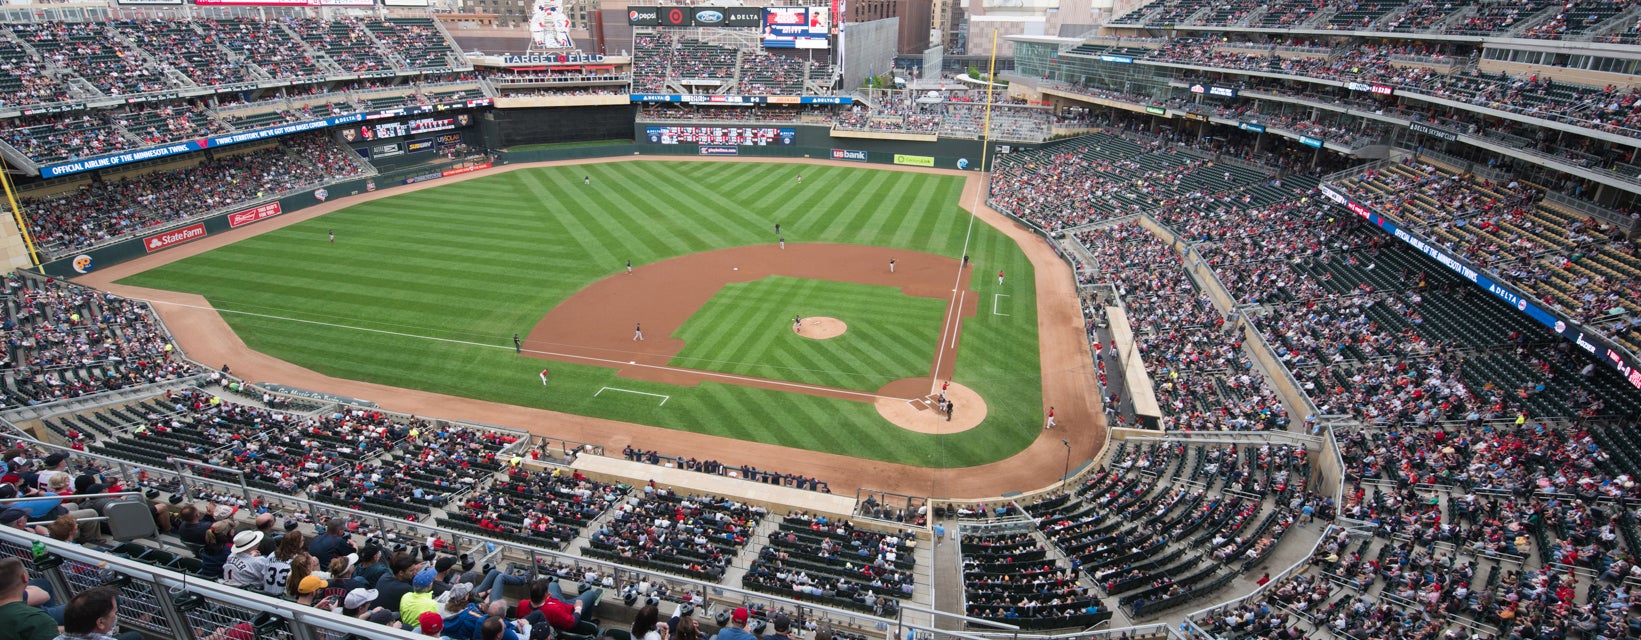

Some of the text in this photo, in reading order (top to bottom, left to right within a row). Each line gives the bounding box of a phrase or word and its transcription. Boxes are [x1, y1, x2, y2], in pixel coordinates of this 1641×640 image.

[701, 12, 718, 21] Ford
[503, 54, 605, 63] TARGET FIELD
[214, 136, 232, 145] TWINS
[260, 130, 274, 138] WE'VE
[274, 128, 284, 136] GOT
[284, 126, 296, 134] YOUR
[296, 124, 309, 132] BASES
[1413, 124, 1428, 133] DELTA
[409, 141, 432, 150] SUBWAY
[52, 162, 83, 175] OFFICIAL
[84, 158, 109, 170] AIRLINE
[111, 156, 120, 164] OF
[120, 154, 134, 163] THE
[134, 148, 169, 160] MINNESOTA
[1394, 228, 1410, 243] OFFICIAL
[1410, 236, 1425, 250] AIRLINE
[1424, 245, 1430, 253] OF
[1429, 248, 1438, 259] THE
[1437, 253, 1462, 273] MINNESOTA
[1496, 288, 1516, 304] DELTA
[228, 569, 232, 580] 1
[266, 567, 290, 587] 33
